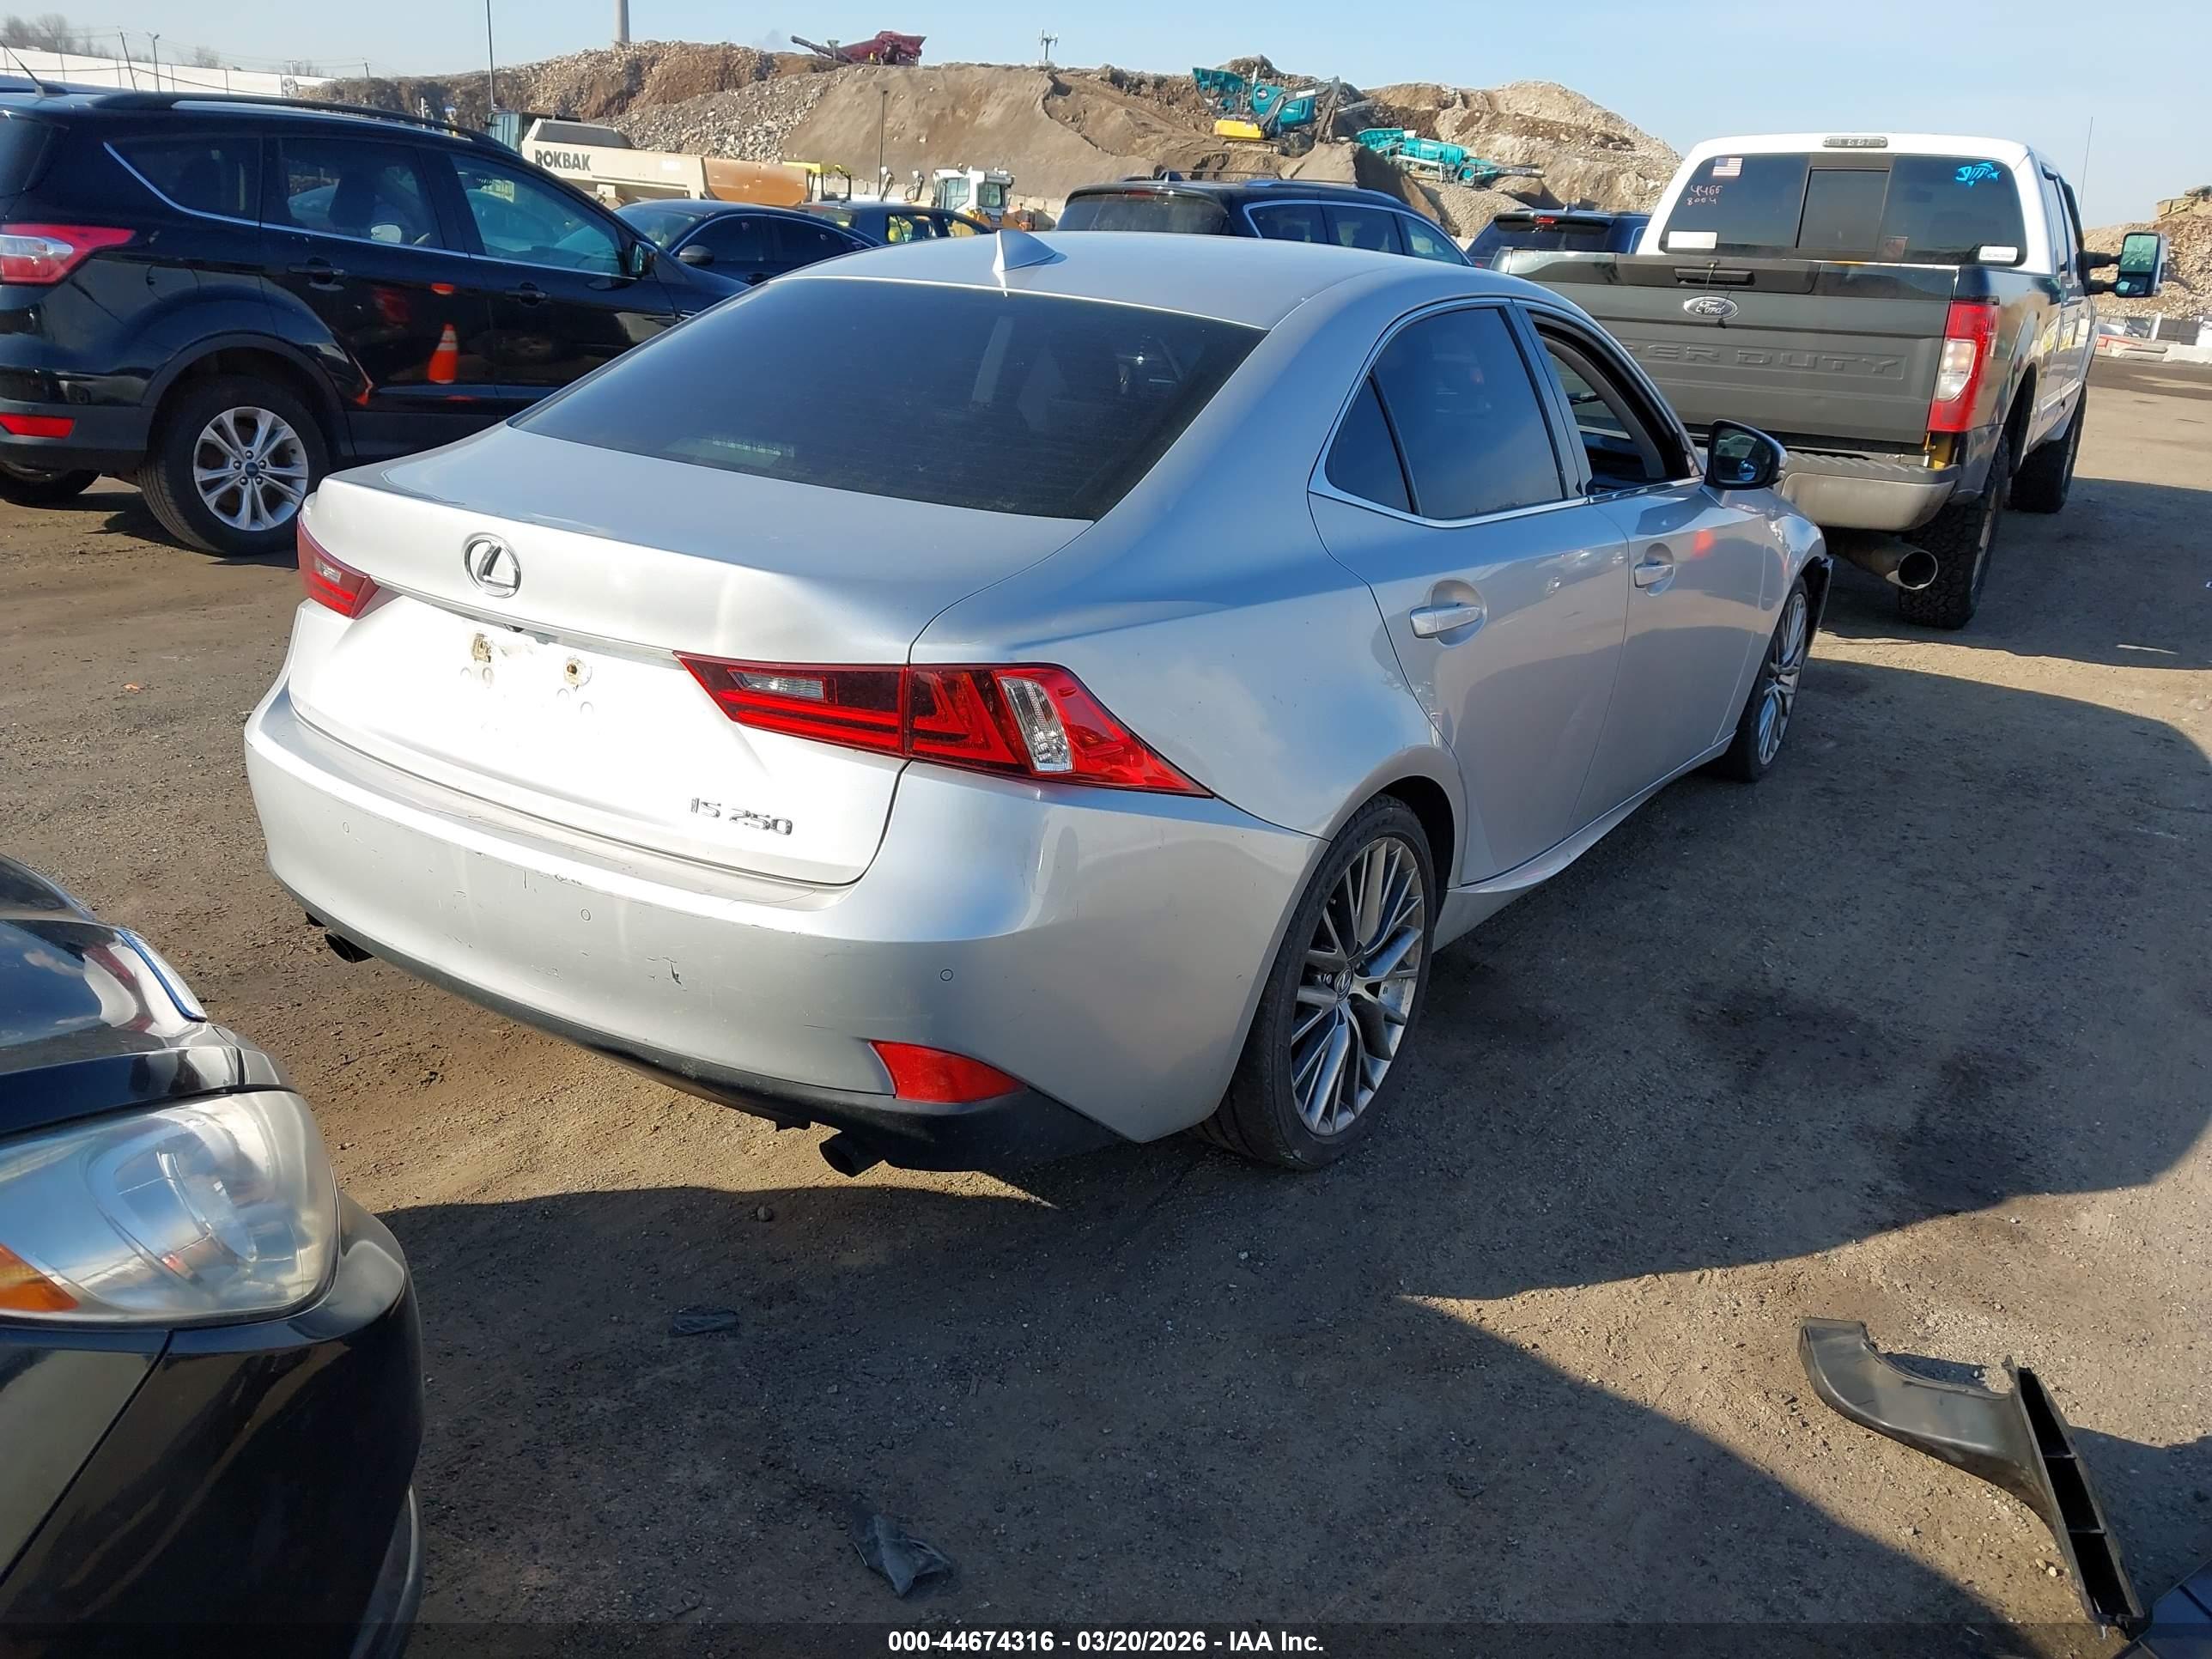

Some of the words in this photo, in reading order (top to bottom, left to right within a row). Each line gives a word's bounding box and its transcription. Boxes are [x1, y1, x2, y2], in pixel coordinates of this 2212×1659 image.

[534, 149, 591, 172] ROKBAK
[1737, 348, 1899, 374] DUTY
[690, 797, 721, 818] IS
[729, 807, 793, 836] 250
